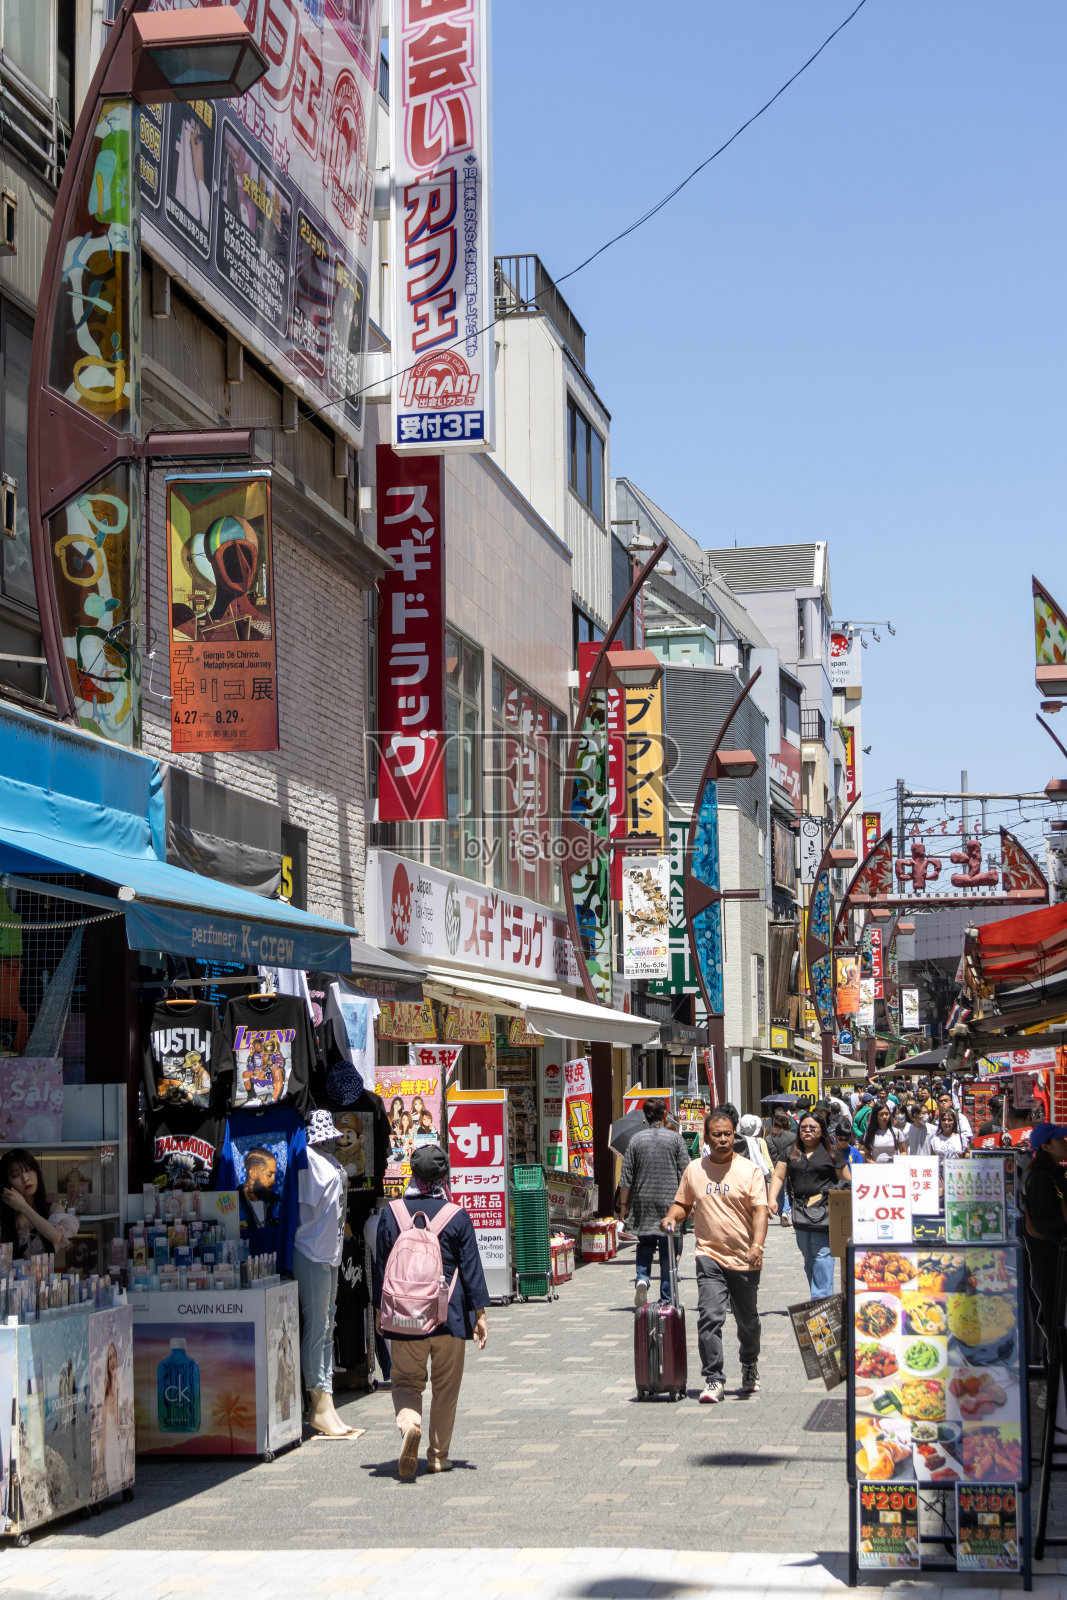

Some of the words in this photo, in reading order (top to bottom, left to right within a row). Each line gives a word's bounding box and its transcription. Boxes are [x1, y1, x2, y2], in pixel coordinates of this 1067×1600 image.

[399, 369, 480, 407] KIRARI
[401, 412, 481, 440] 受付3F
[383, 485, 436, 778] スギドラッグ
[203, 651, 225, 660] Giorgio
[227, 651, 235, 659] De
[203, 661, 245, 671] Metaphysical
[246, 660, 272, 669] Journey
[174, 677, 273, 704] キリコ展
[174, 711, 197, 725] 4.27
[216, 710, 238, 724] 8.29
[464, 891, 548, 969] スギドラッグ
[191, 924, 238, 953] perfumery
[241, 924, 295, 964] K-crew
[151, 1027, 212, 1063] HUSTL
[233, 1025, 297, 1051] LEGEND
[790, 1079, 810, 1092] ALL
[155, 1135, 214, 1168] BACKWOODS
[450, 1174, 504, 1185] ギドラッグ
[705, 1182, 730, 1196] GAP
[855, 1184, 906, 1200] タバコ
[458, 1194, 502, 1209] 化粧品
[469, 1210, 502, 1219] smetics
[875, 1206, 906, 1220] OK
[479, 1234, 504, 1243] Japan.
[477, 1243, 504, 1251] ax-free
[485, 1251, 504, 1259] Shop
[177, 1304, 213, 1315] CALVIN
[215, 1303, 243, 1314] KLEIN
[861, 1492, 918, 1510] ¥290
[959, 1493, 1017, 1512] ¥290
